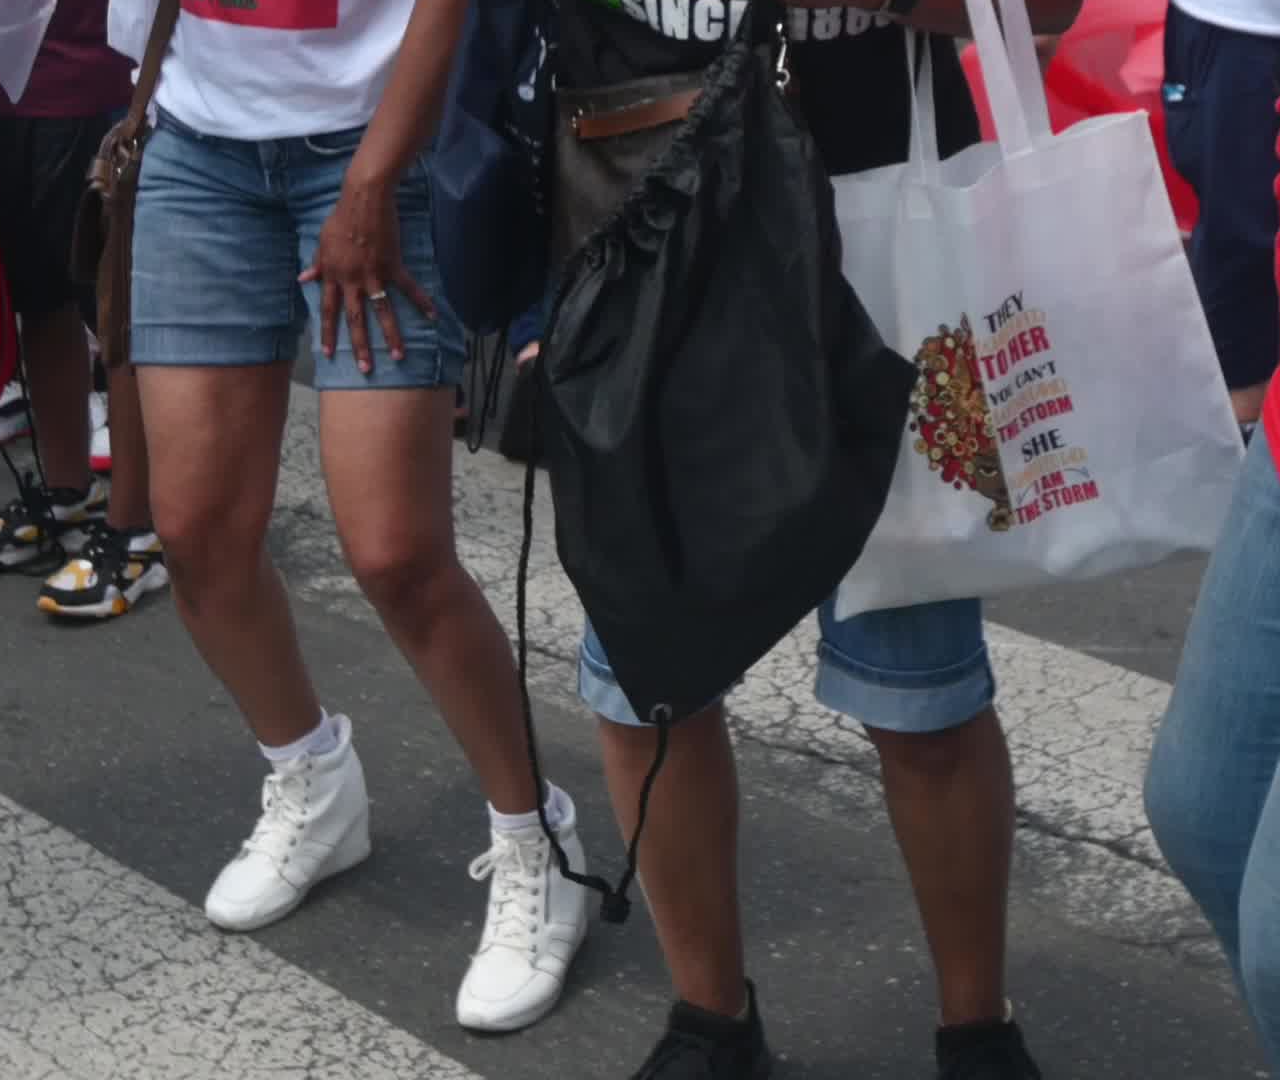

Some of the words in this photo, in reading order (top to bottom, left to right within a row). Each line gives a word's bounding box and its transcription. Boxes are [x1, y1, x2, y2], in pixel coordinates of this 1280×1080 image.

[983, 288, 1024, 334] THEY
[980, 348, 1010, 381] TO
[1008, 325, 1052, 366] HER
[997, 416, 1020, 443] THE
[1019, 394, 1074, 429] STORM
[1021, 427, 1066, 464] SHE
[1015, 497, 1042, 525] THE
[1041, 479, 1100, 511] STORM
[1040, 469, 1066, 491] AM
